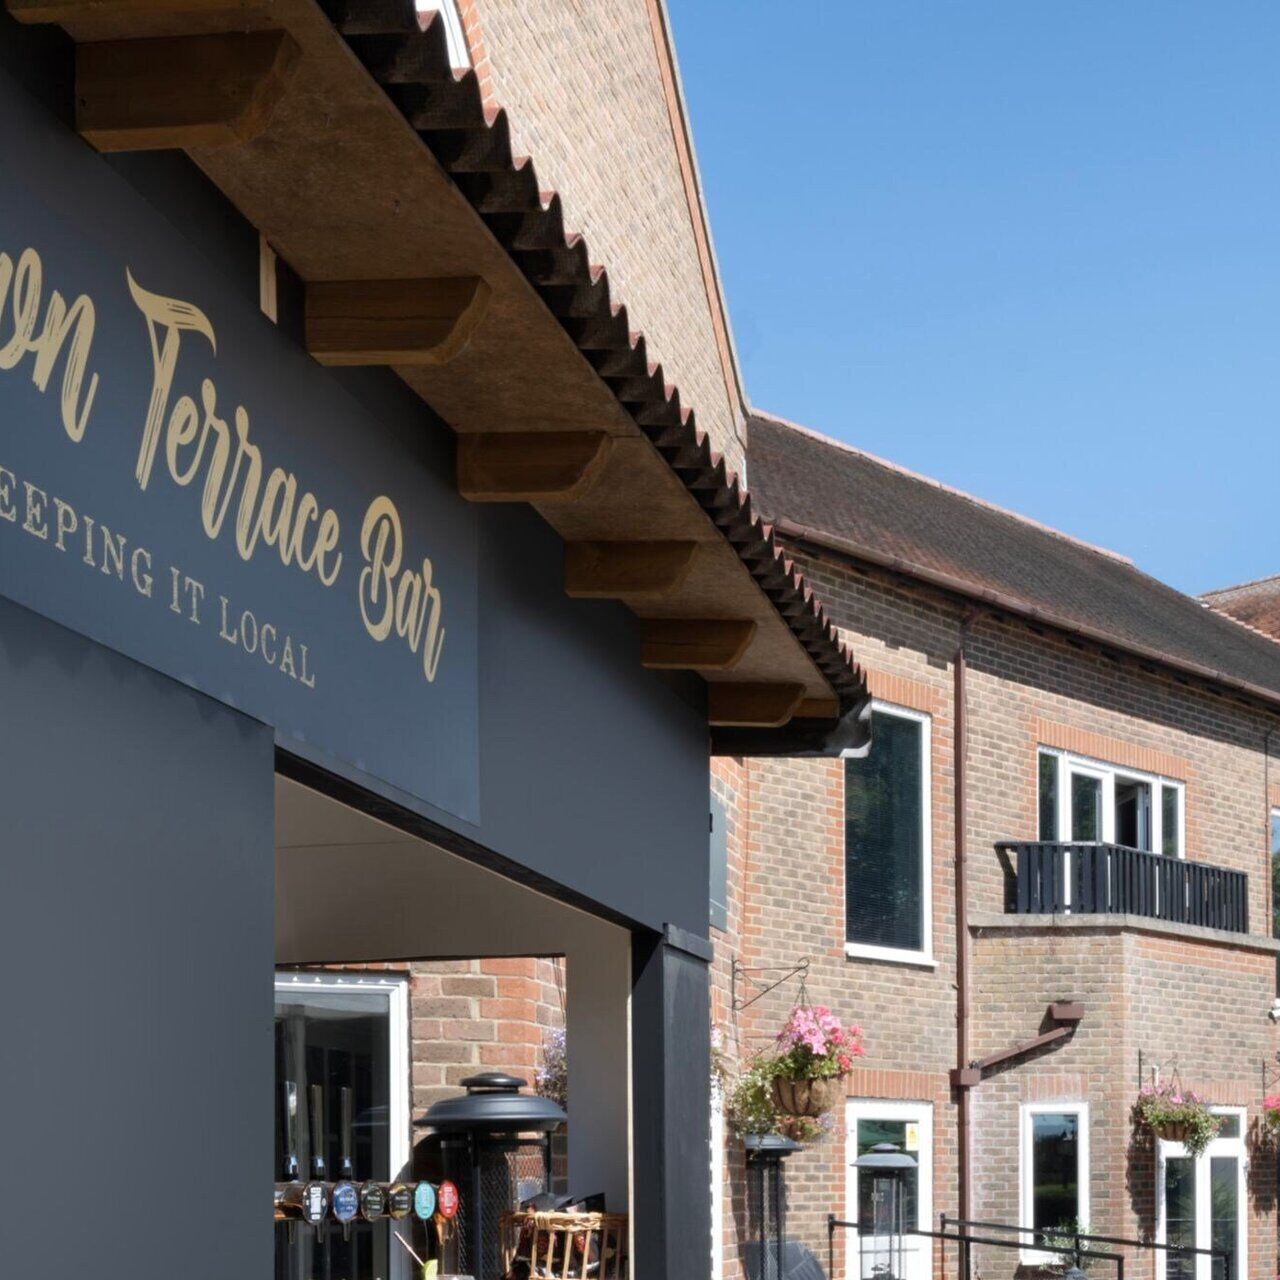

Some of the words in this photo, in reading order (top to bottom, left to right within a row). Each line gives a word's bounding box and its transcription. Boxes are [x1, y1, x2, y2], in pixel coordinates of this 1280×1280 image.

[126, 265, 342, 587] Terrace
[359, 495, 445, 682] Bar
[169, 566, 205, 624] IT
[219, 595, 316, 688] LOCAL
